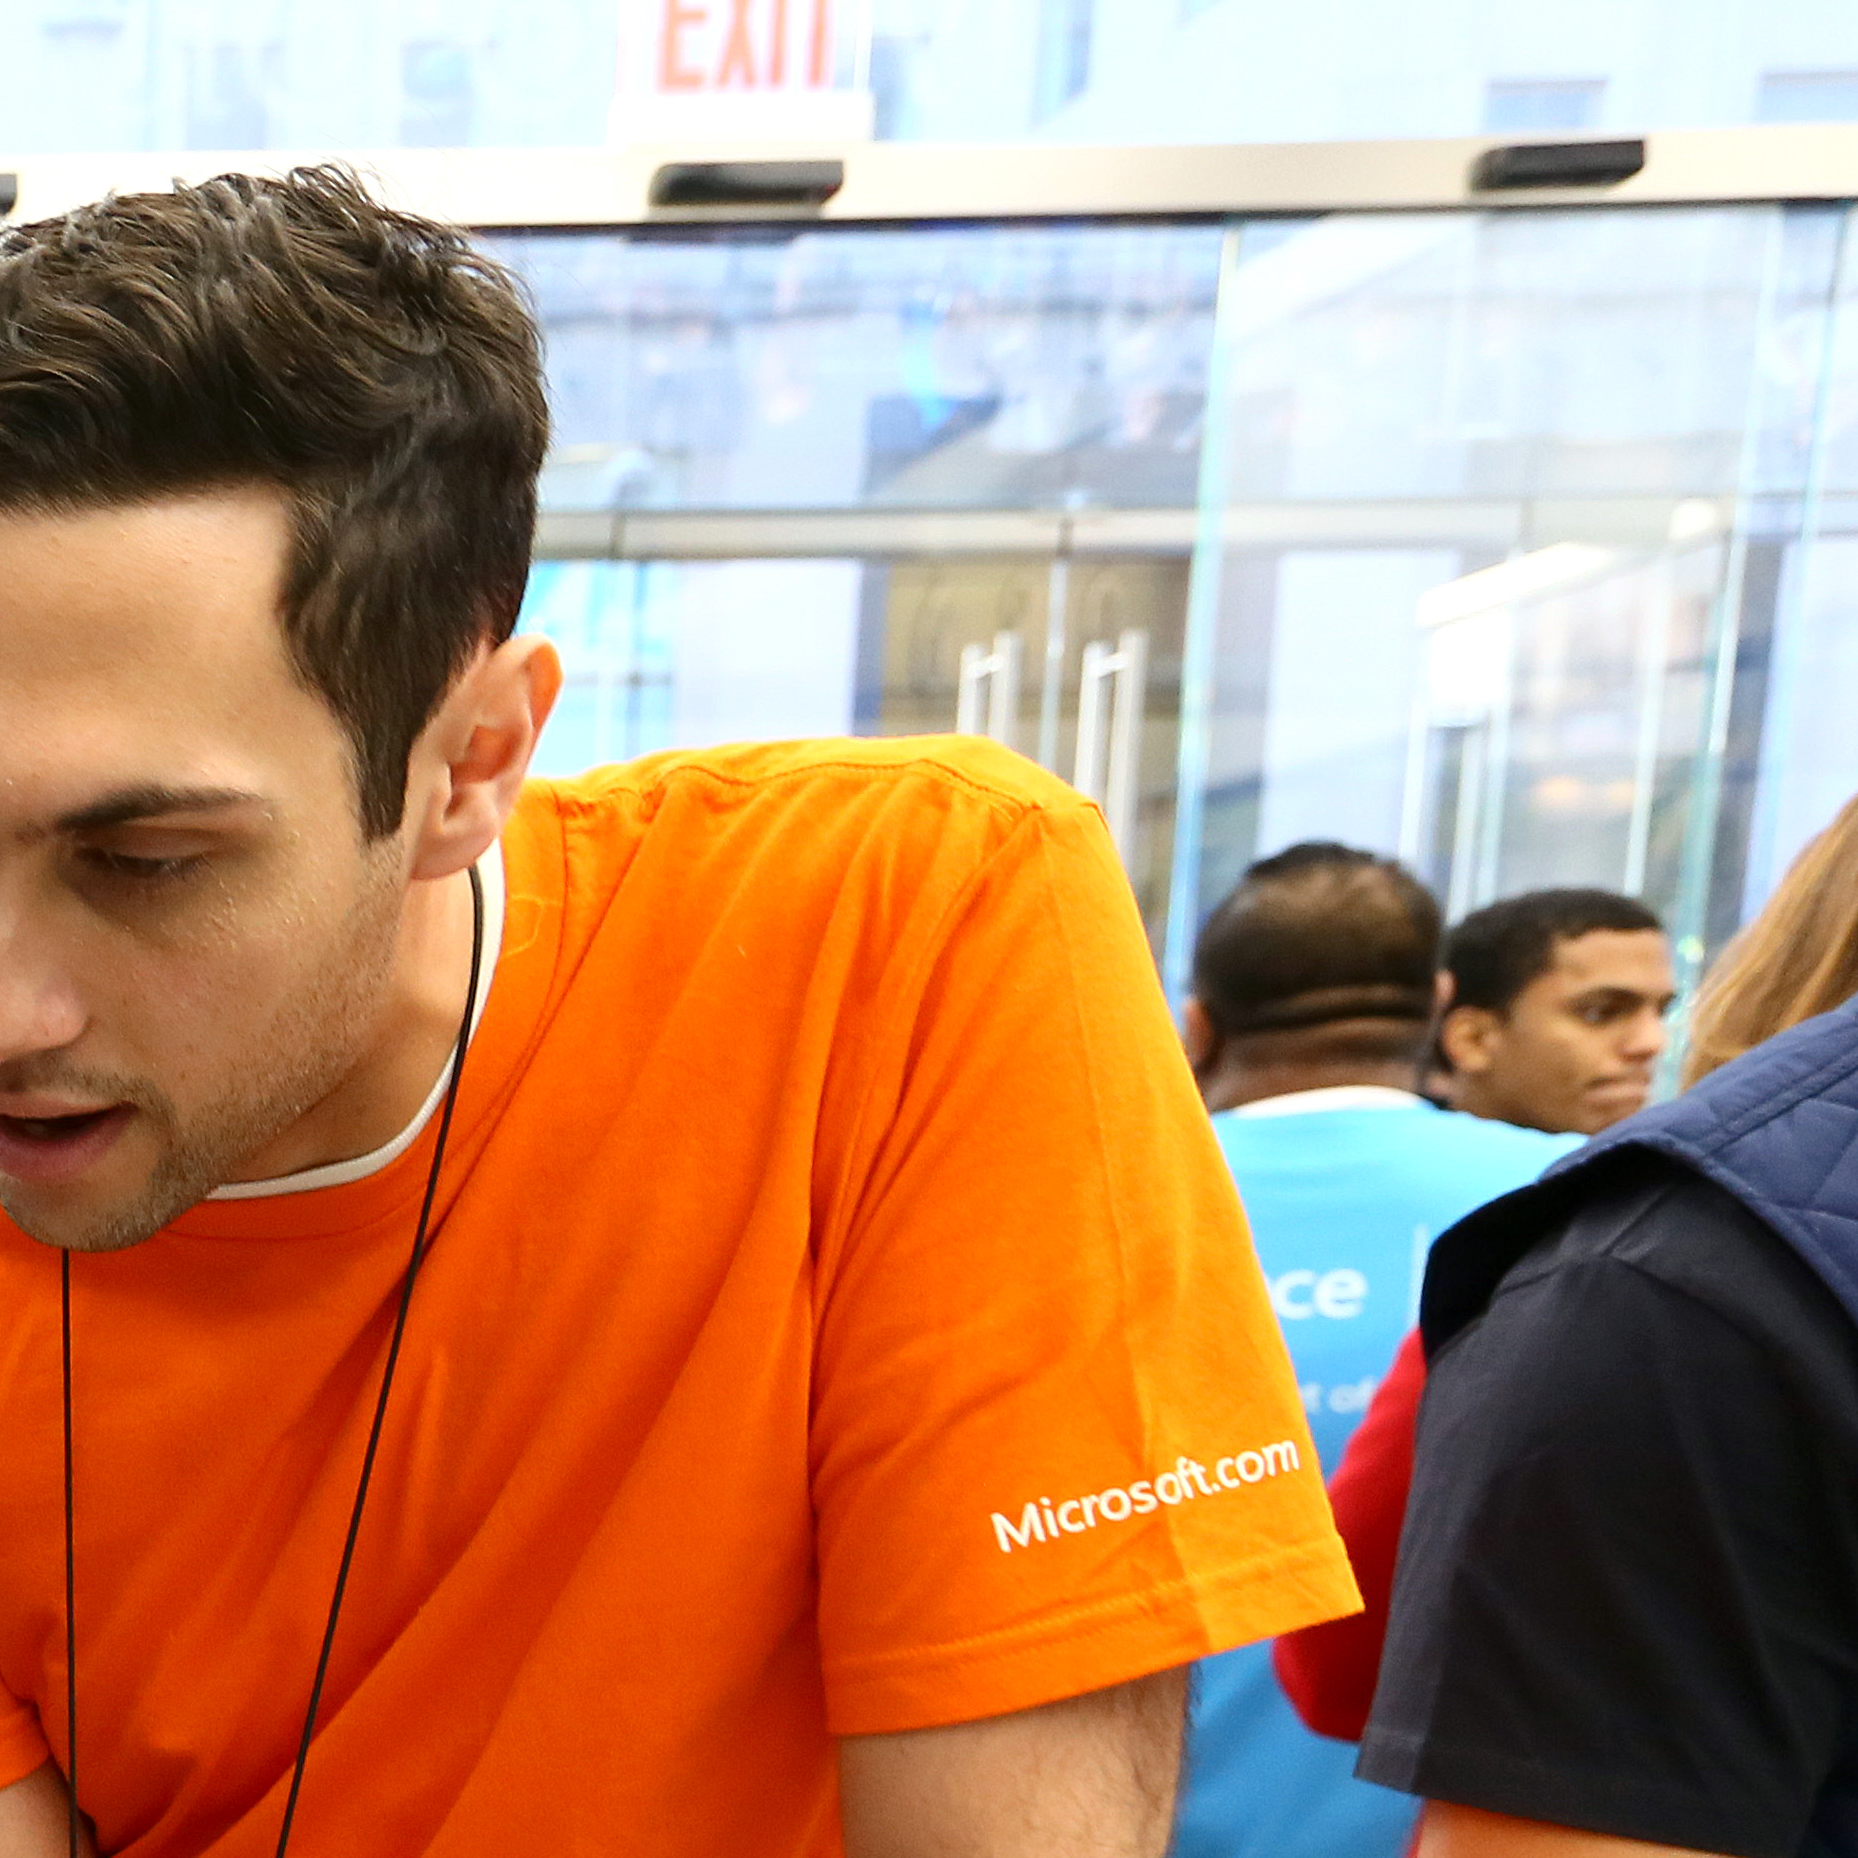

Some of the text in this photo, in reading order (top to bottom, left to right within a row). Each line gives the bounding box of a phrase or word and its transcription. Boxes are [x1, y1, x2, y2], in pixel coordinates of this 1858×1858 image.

[659, 0, 833, 88] EXIT
[1268, 1268, 1369, 1320] ce
[990, 1437, 1300, 1552] Microsoft.com
